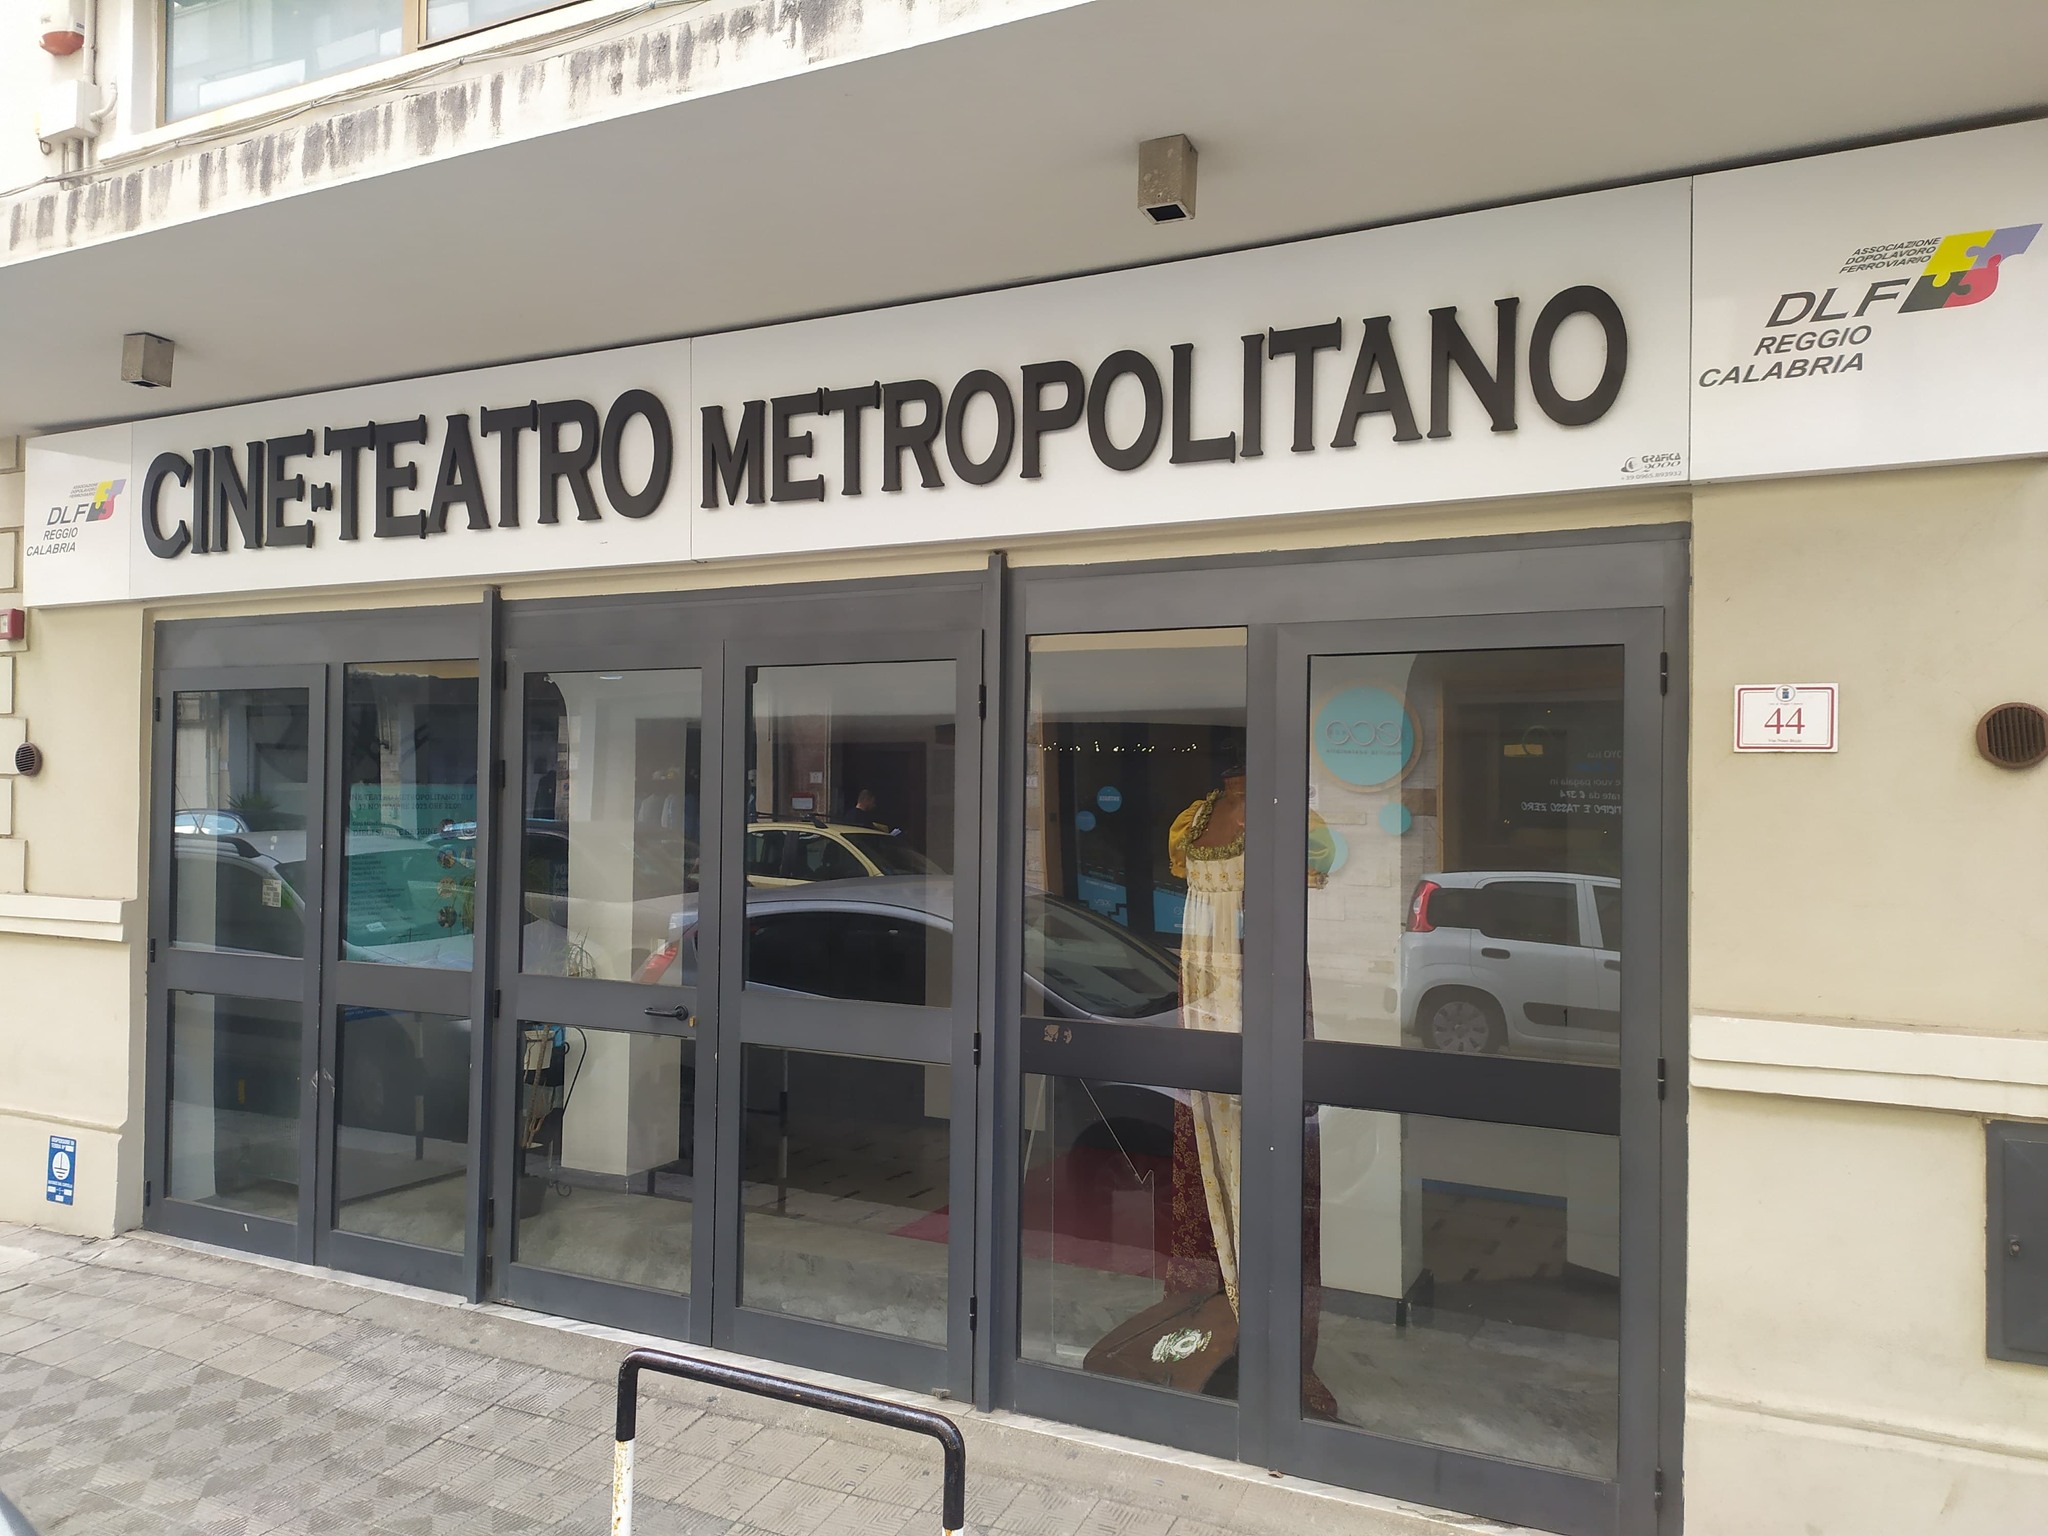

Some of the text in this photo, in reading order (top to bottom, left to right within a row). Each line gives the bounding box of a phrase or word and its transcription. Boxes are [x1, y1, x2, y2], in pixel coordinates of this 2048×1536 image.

[1845, 246, 1937, 265] DOPOLAVORO
[1851, 237, 1942, 256] ASSOCIAZIONE
[1839, 255, 1932, 274] FERROVIARIO
[1765, 277, 1912, 328] DLF
[1753, 325, 1873, 356] REGGIO
[1698, 352, 1864, 388] CALABRIA
[700, 284, 1629, 510] METROPOLITANO
[1641, 453, 1681, 463] GRAFICA
[47, 503, 89, 525] DLF
[43, 527, 79, 541] REGGIO
[26, 542, 77, 557] CALABRIA
[1764, 707, 1805, 734] 44
